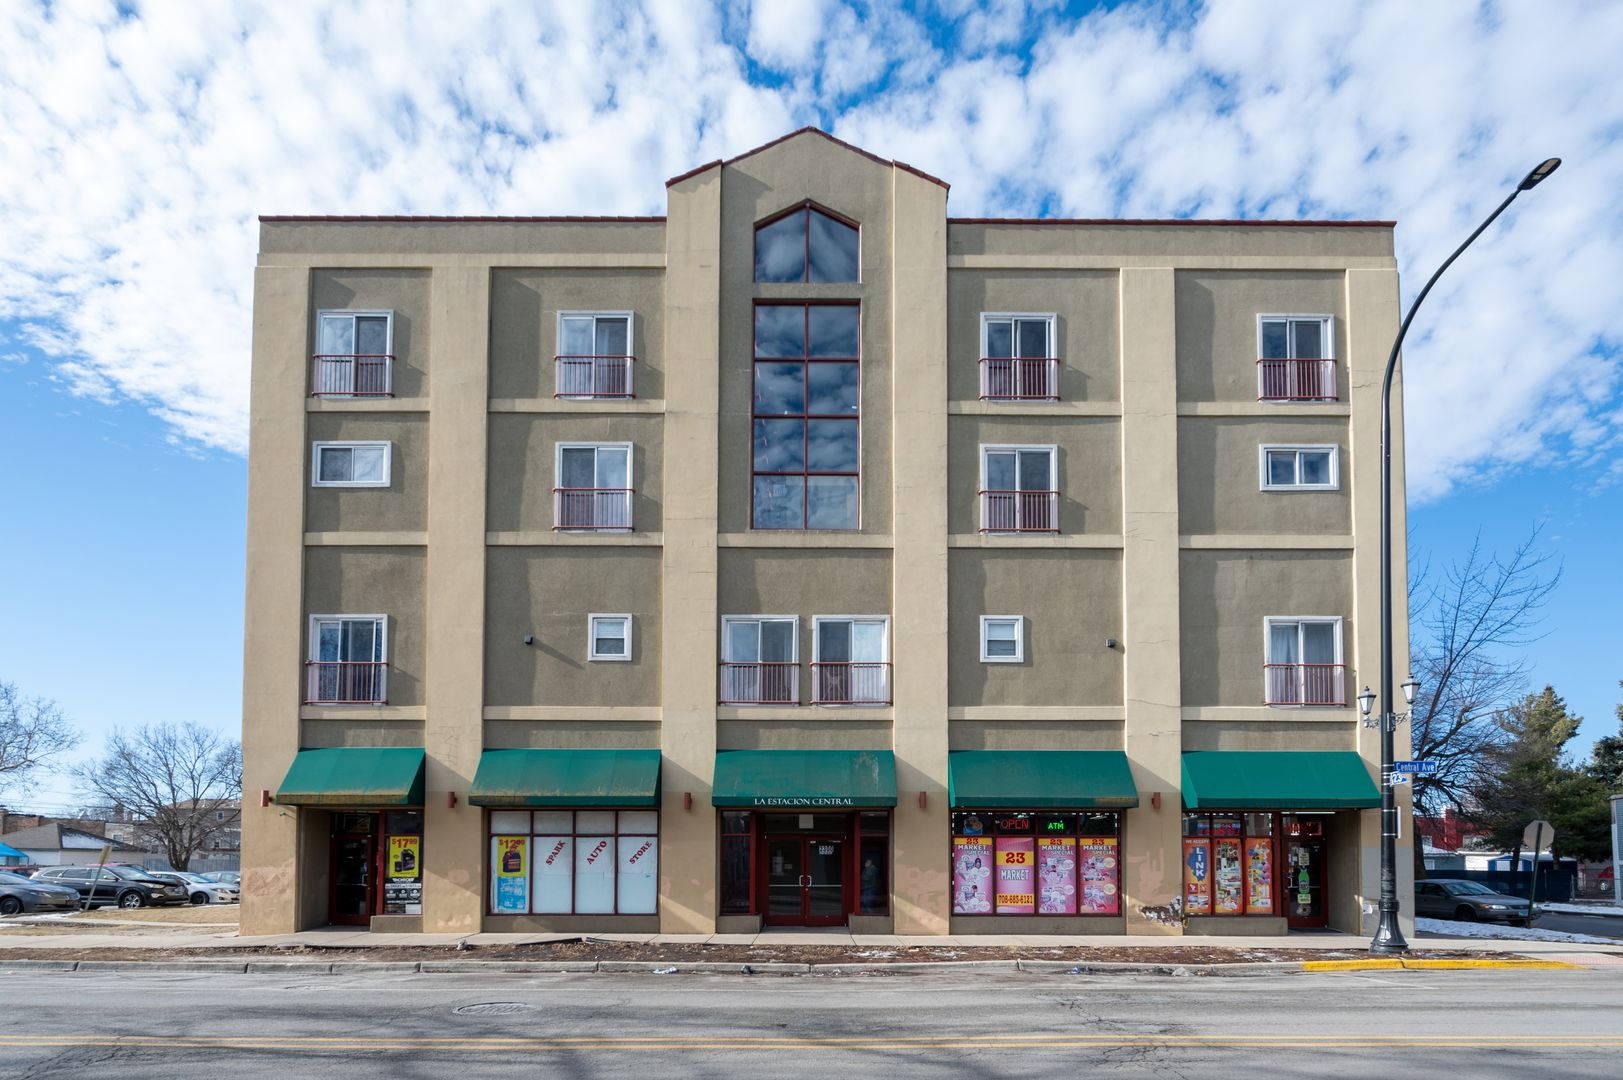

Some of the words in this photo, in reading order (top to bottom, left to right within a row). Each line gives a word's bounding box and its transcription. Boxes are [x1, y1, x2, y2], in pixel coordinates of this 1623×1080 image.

[1396, 763, 1419, 772] Central
[1421, 763, 1435, 772] Ave
[1001, 819, 1029, 829] OPEN
[1048, 822, 1064, 830] ATM
[545, 840, 566, 866] SPARK
[586, 840, 608, 865] AUTO
[629, 841, 653, 865] STORE
[1005, 852, 1026, 864] 23
[1195, 847, 1204, 877] LINK
[1000, 869, 1030, 881] MARKET
